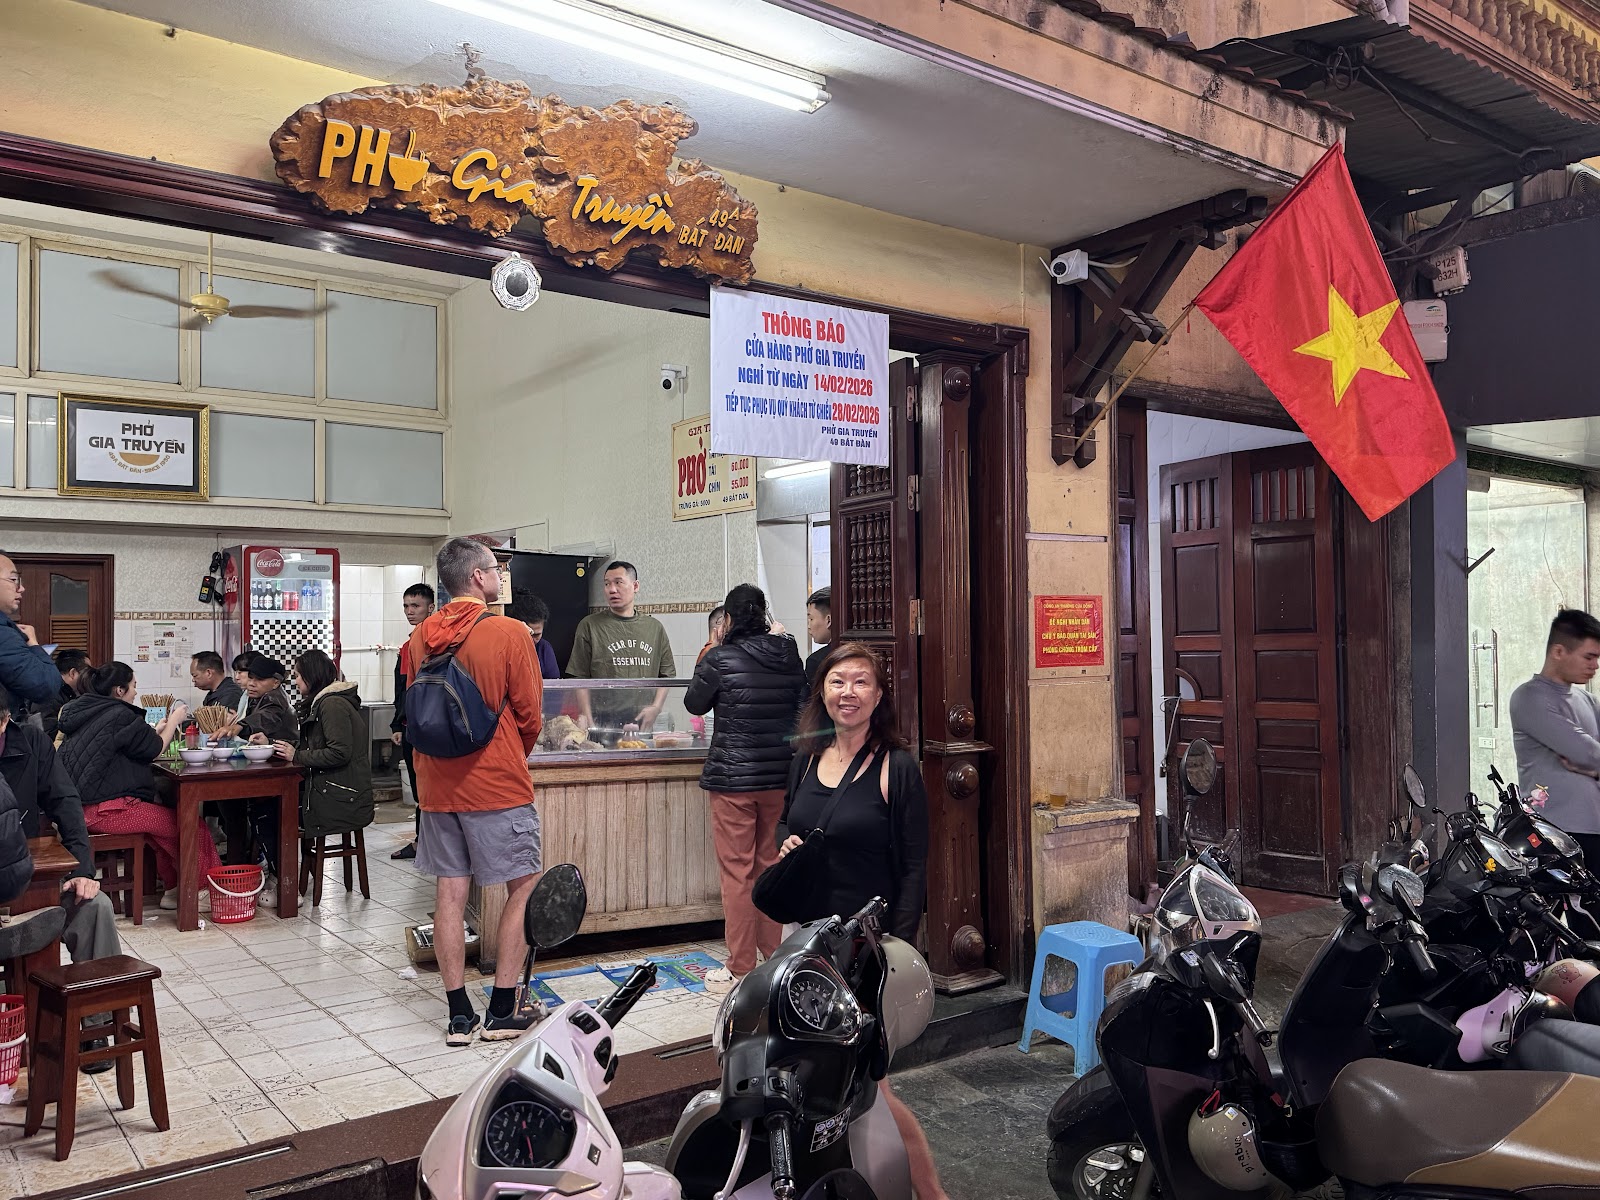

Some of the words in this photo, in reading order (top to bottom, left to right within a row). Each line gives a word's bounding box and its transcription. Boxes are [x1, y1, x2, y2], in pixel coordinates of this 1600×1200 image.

[452, 149, 537, 206] Gia
[571, 176, 676, 245] Truyền
[678, 217, 709, 248] BÁT
[713, 224, 746, 255] ĐÀN
[762, 310, 812, 340] THÔNG
[816, 317, 846, 344] BÁO
[745, 332, 765, 359] CỬA
[767, 338, 793, 362] HÀNG
[795, 340, 814, 365] PHỞ
[815, 348, 831, 367] GIA
[738, 364, 764, 386] NGHỈ
[766, 366, 781, 387] TỪ
[782, 370, 809, 390] NGÀY
[813, 373, 873, 397] 14/02/2026
[725, 388, 739, 412] TIẾP
[739, 395, 751, 417] TỤC
[752, 396, 768, 419] PHỤC
[768, 398, 777, 419] VỤ
[777, 396, 788, 418] QUÝ
[789, 397, 808, 419] KHÁCH
[808, 398, 817, 420] TỪ
[832, 402, 880, 425] 28/02/2026
[121, 419, 154, 437] PHỞ
[821, 423, 837, 435] PHỞ
[837, 427, 850, 436] GIA
[88, 436, 116, 450] GIA
[830, 438, 839, 446] 49
[840, 437, 854, 447] BÁT
[678, 436, 707, 498] PHỞ
[708, 463, 717, 477] TÁI
[731, 476, 749, 490] 55.000
[608, 639, 626, 654] FEAR
[627, 639, 637, 648] OF
[639, 640, 653, 655] GOD
[612, 656, 651, 667] ESSENTIALS
